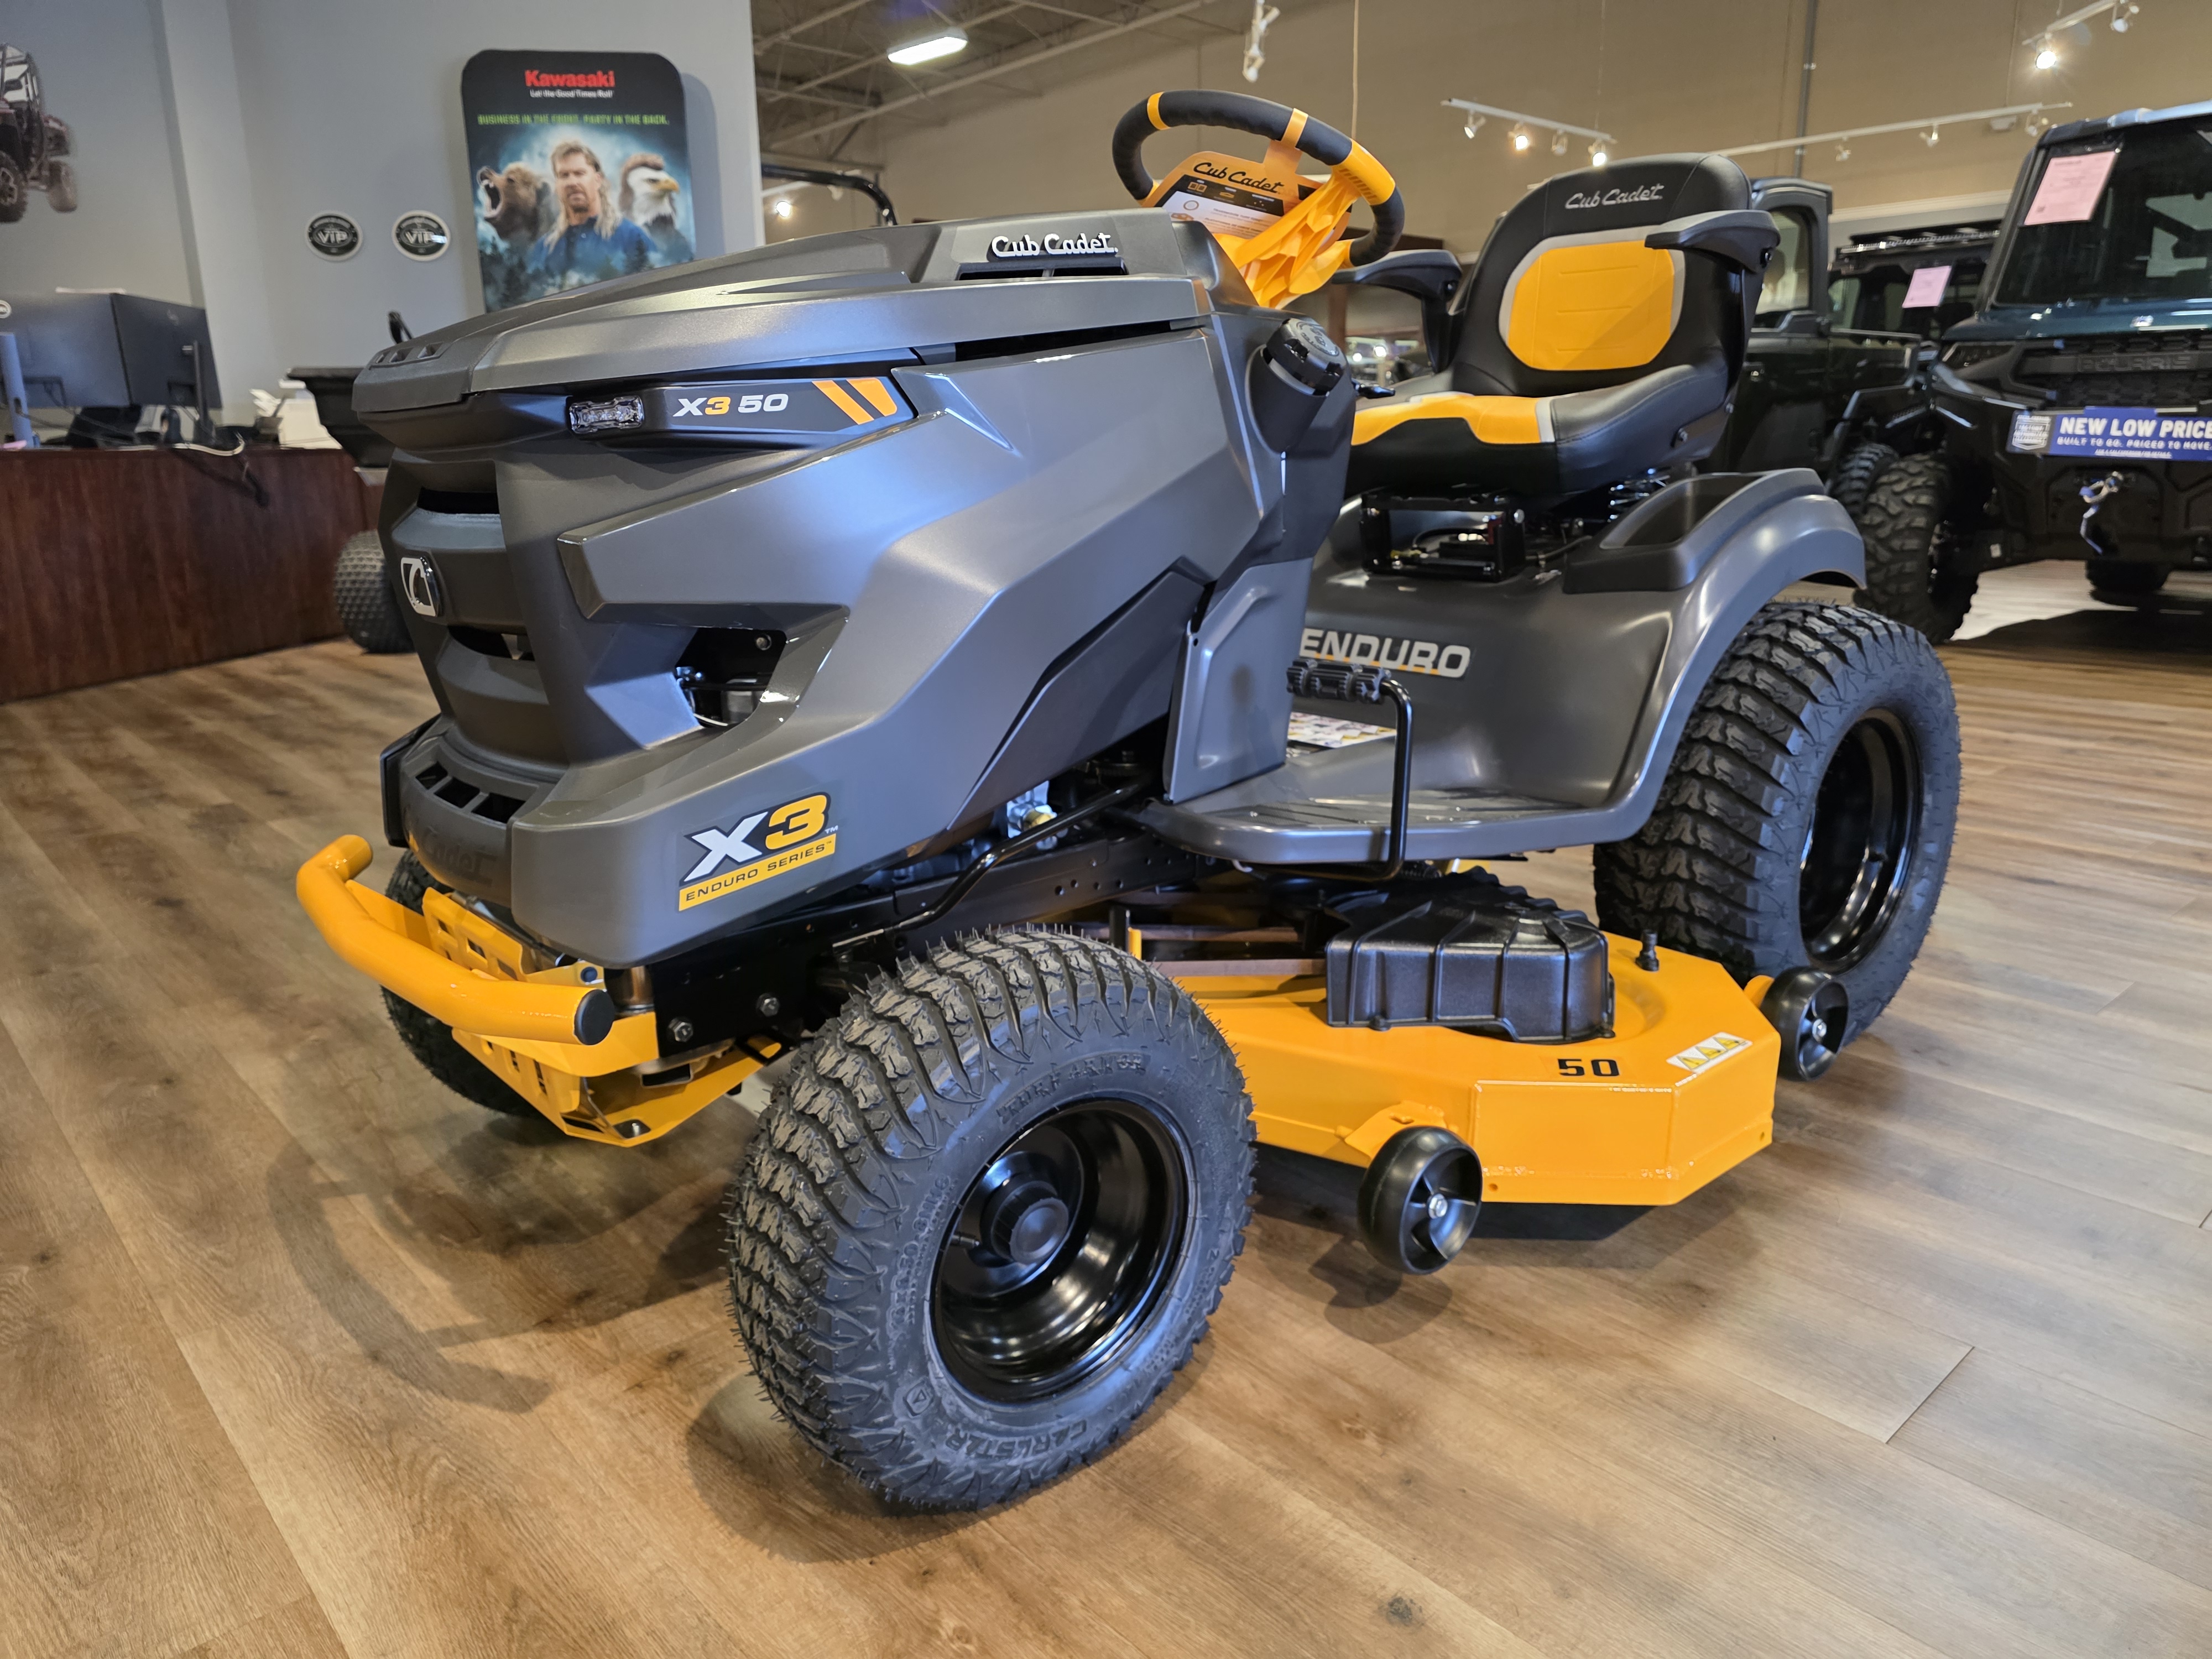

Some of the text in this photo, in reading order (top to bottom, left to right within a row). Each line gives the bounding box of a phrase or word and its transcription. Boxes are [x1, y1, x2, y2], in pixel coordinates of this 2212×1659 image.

[525, 70, 615, 87] Kawasaki
[1193, 162, 1284, 194] Cub Cadet
[1564, 183, 1665, 209] Cub Cadet
[317, 230, 348, 244] VIP
[405, 230, 436, 244] VIP
[992, 234, 1040, 257] Cub
[672, 393, 789, 418] X3 50
[2060, 416, 2107, 436] NEW
[2110, 419, 2157, 437] LOW
[2057, 436, 2088, 446] BUILT
[2090, 437, 2104, 447] TO
[2126, 439, 2165, 449] PRICED
[2168, 440, 2181, 449] TO
[1300, 628, 1470, 678] ENDURO
[684, 795, 827, 882] X3
[686, 869, 758, 901] ENDURO
[767, 843, 826, 872] SERIES
[1557, 1058, 1620, 1077] 50
[945, 1419, 1088, 1461] CARLSTAR
